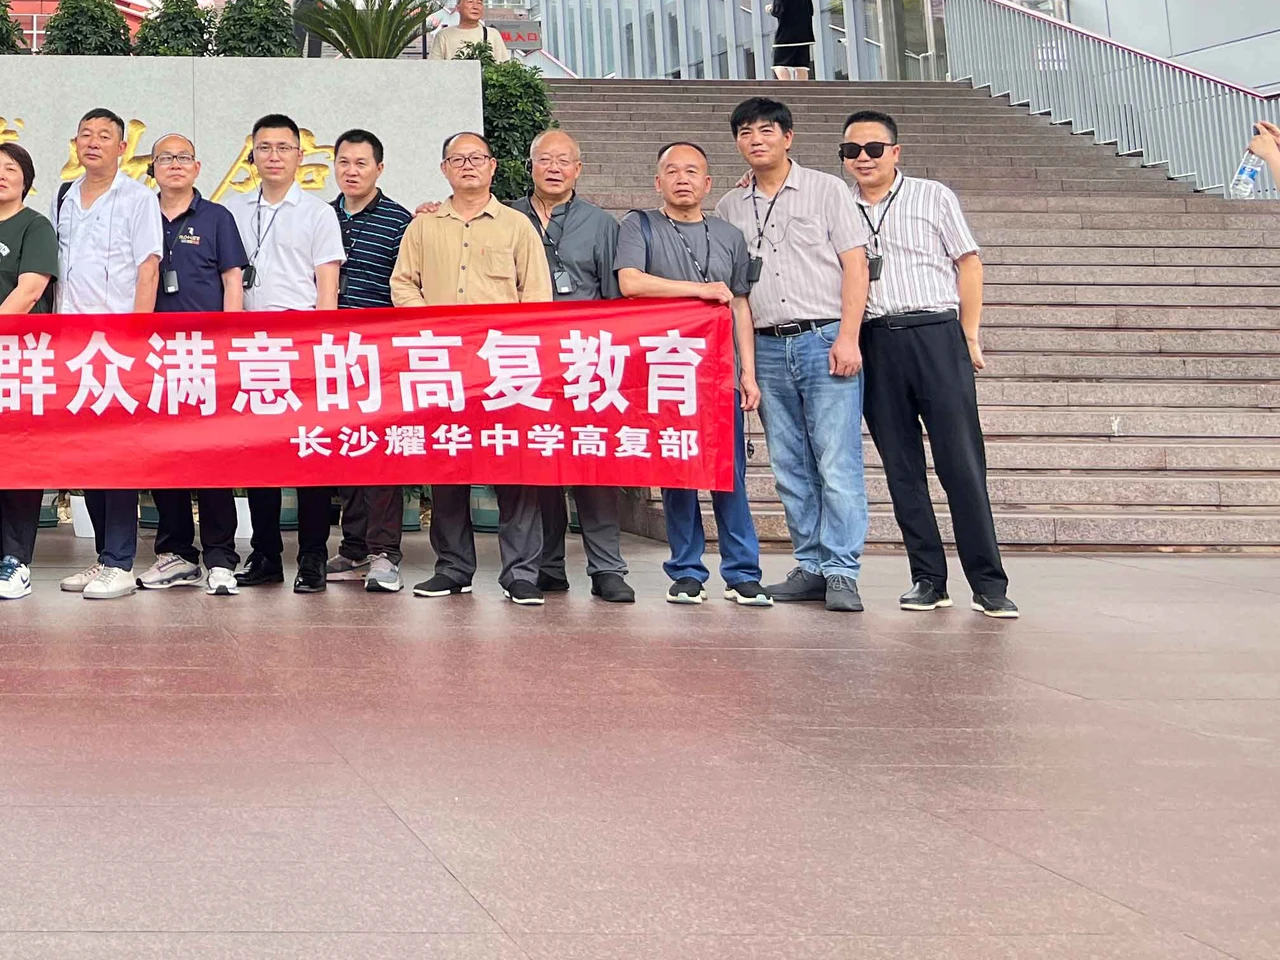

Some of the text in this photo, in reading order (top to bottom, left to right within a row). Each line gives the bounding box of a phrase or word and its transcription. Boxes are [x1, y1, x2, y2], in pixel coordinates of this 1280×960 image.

[290, 423, 699, 461] 长沙耀华中学高复部
